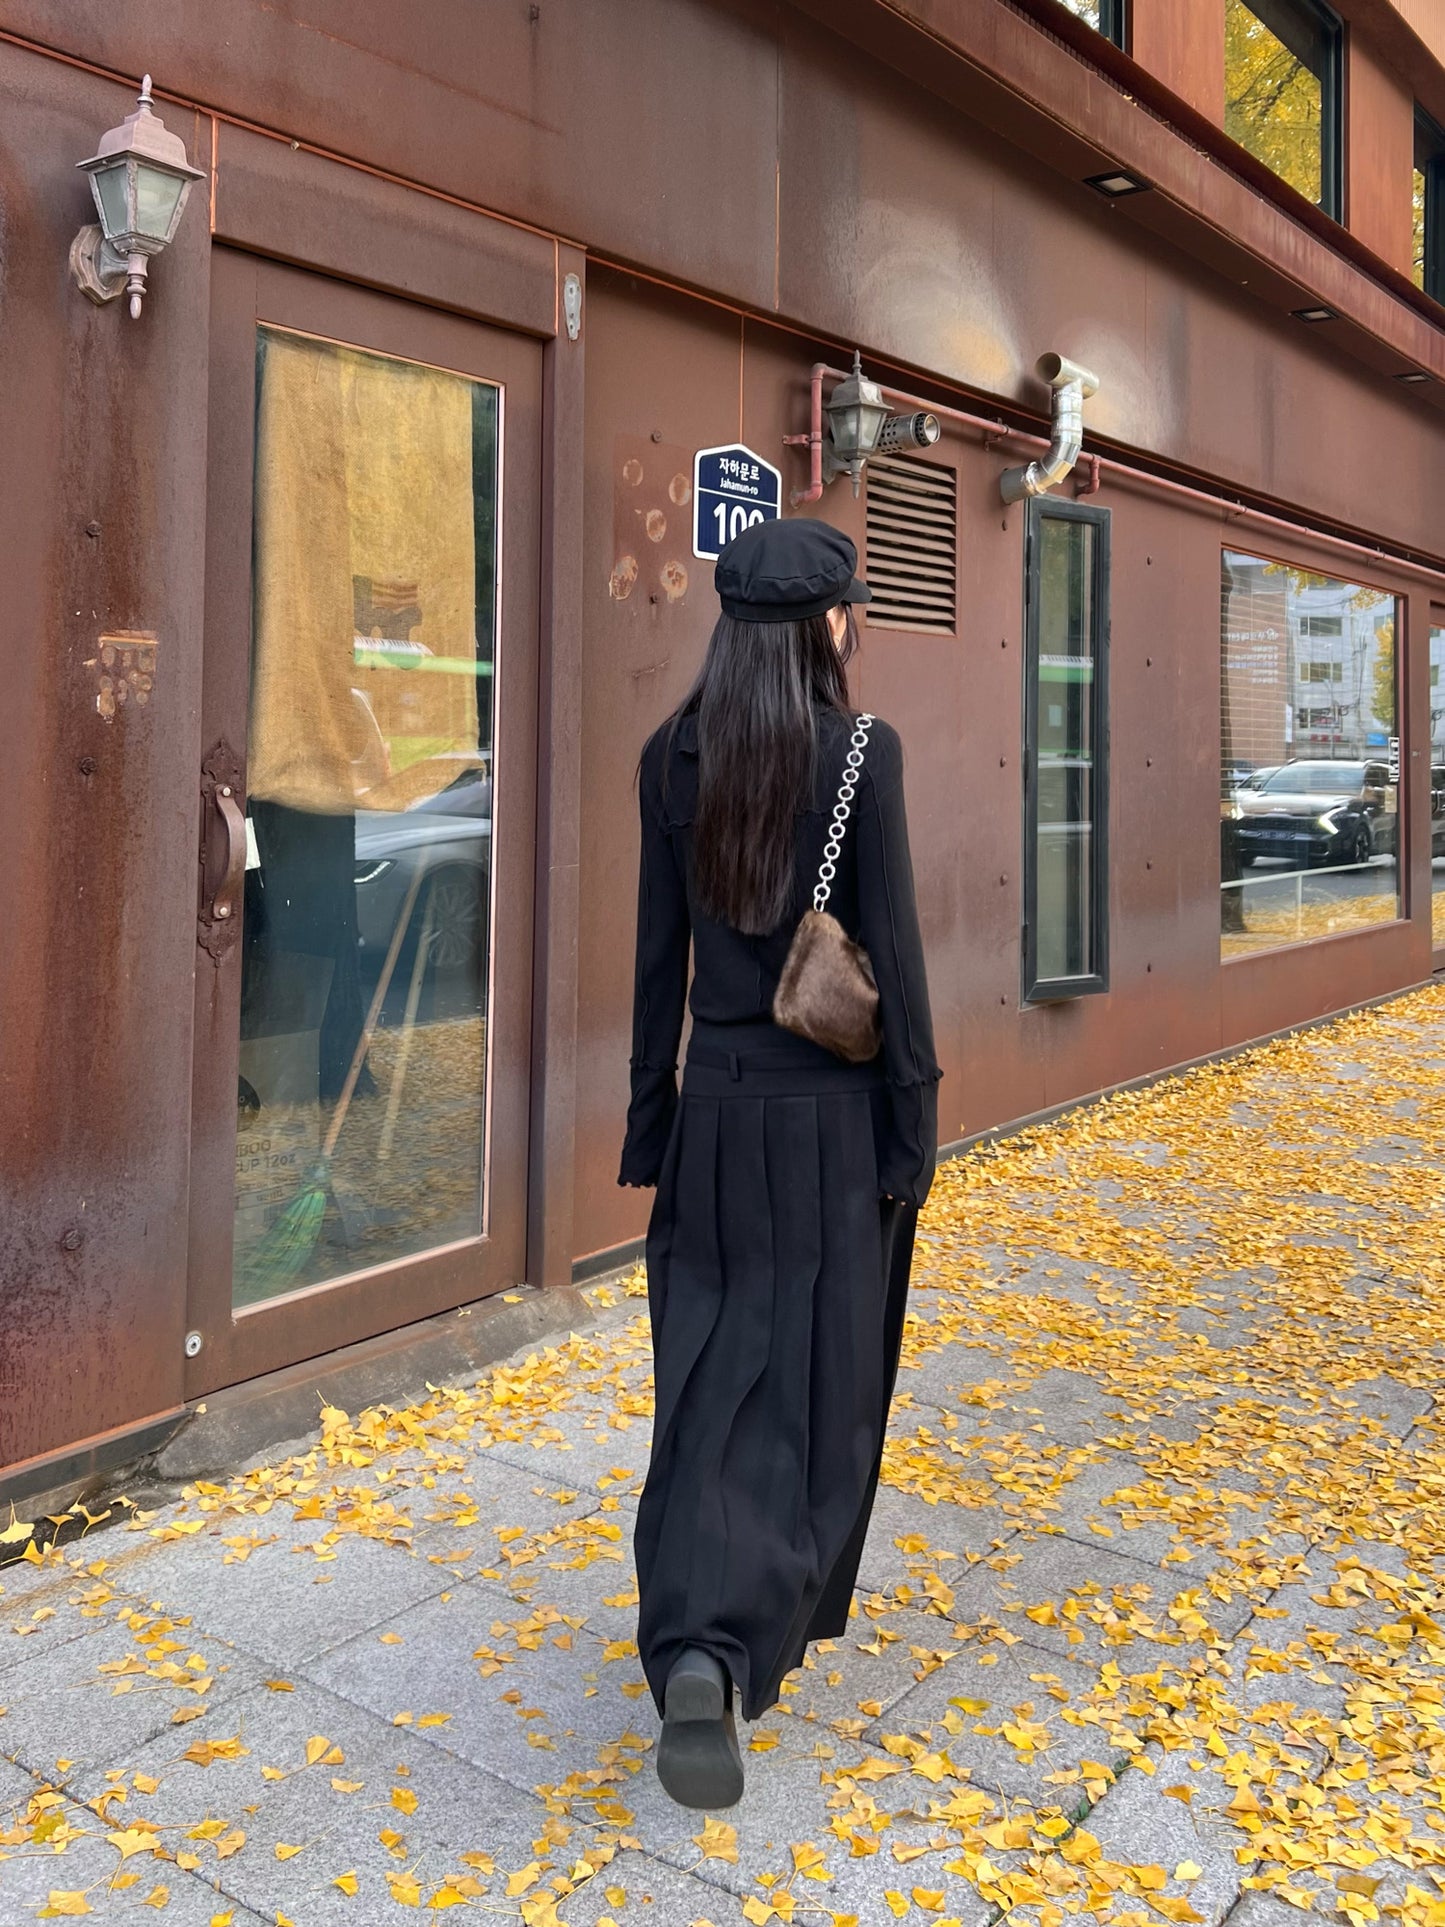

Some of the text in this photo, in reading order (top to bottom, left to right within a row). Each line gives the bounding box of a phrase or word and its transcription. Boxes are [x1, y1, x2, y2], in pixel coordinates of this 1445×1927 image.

[719, 457, 760, 481] 자하문로
[720, 477, 759, 495] Jahamun-ro
[236, 1139, 272, 1158] BOO
